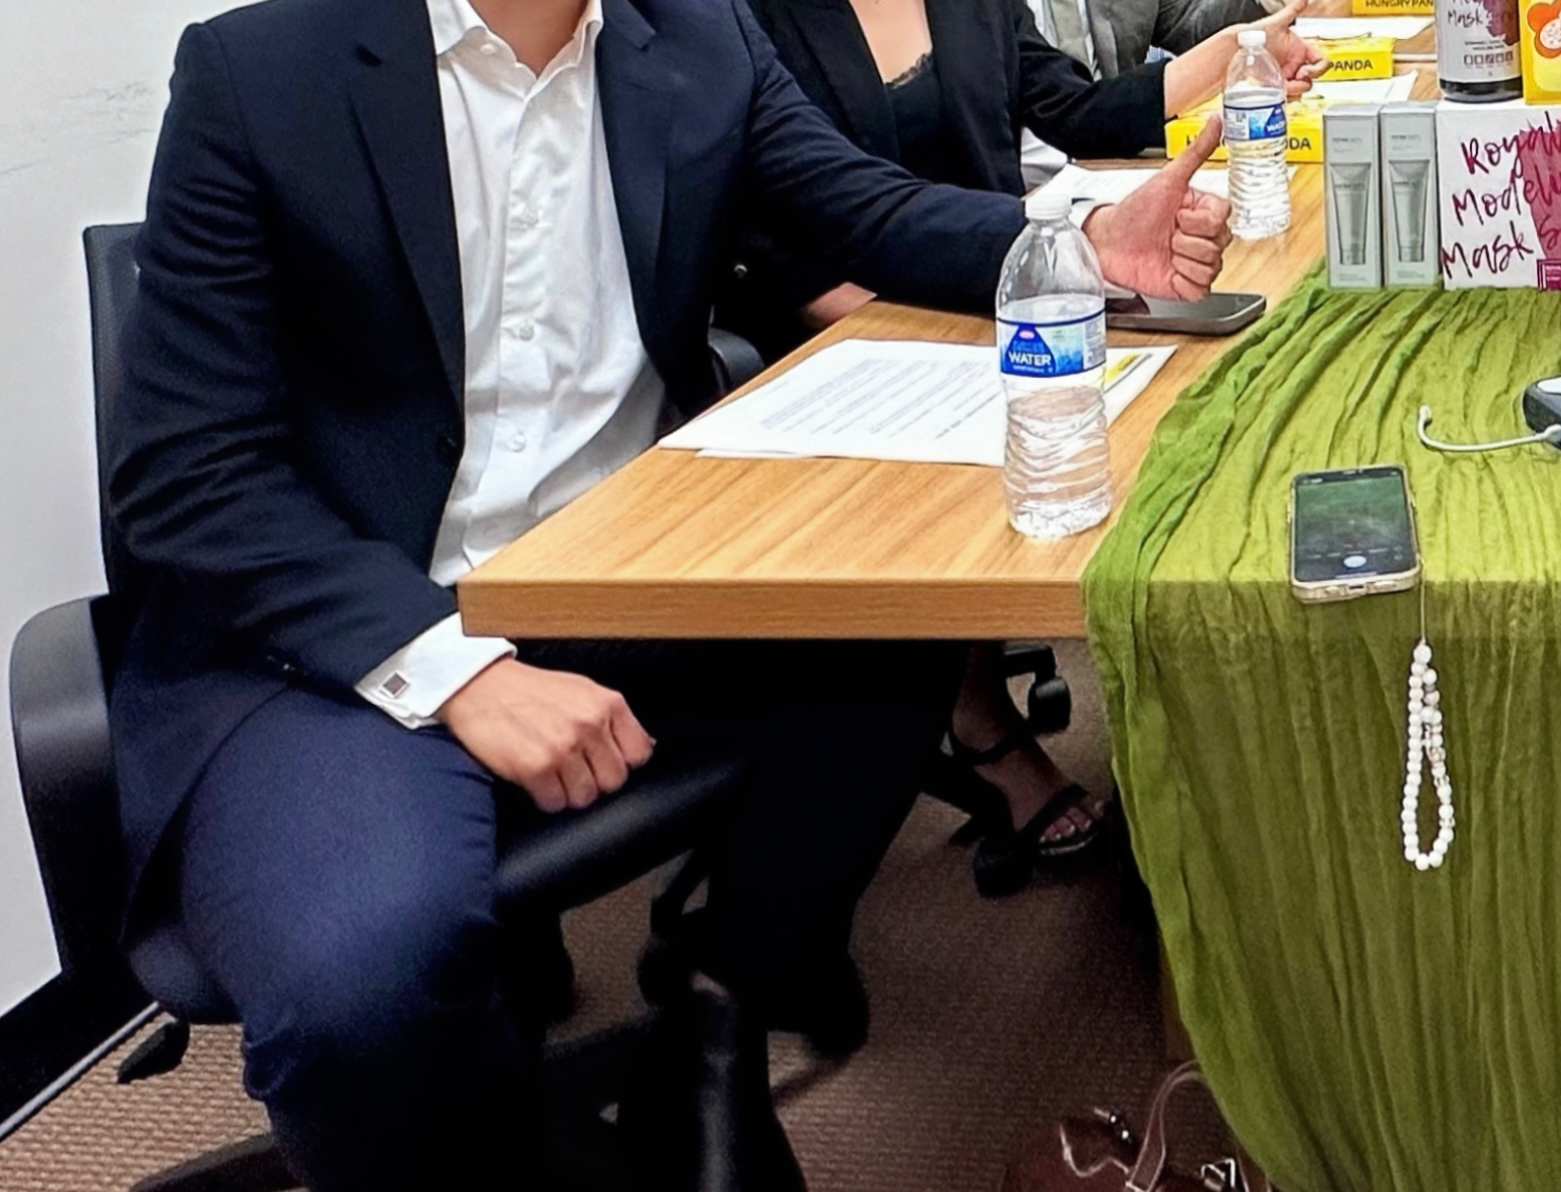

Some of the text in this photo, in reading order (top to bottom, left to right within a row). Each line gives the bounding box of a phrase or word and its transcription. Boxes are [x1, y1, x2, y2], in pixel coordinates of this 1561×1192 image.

[1447, 9, 1484, 29] Mask
[1440, 220, 1535, 280] Mask
[1008, 351, 1052, 367] WATER
